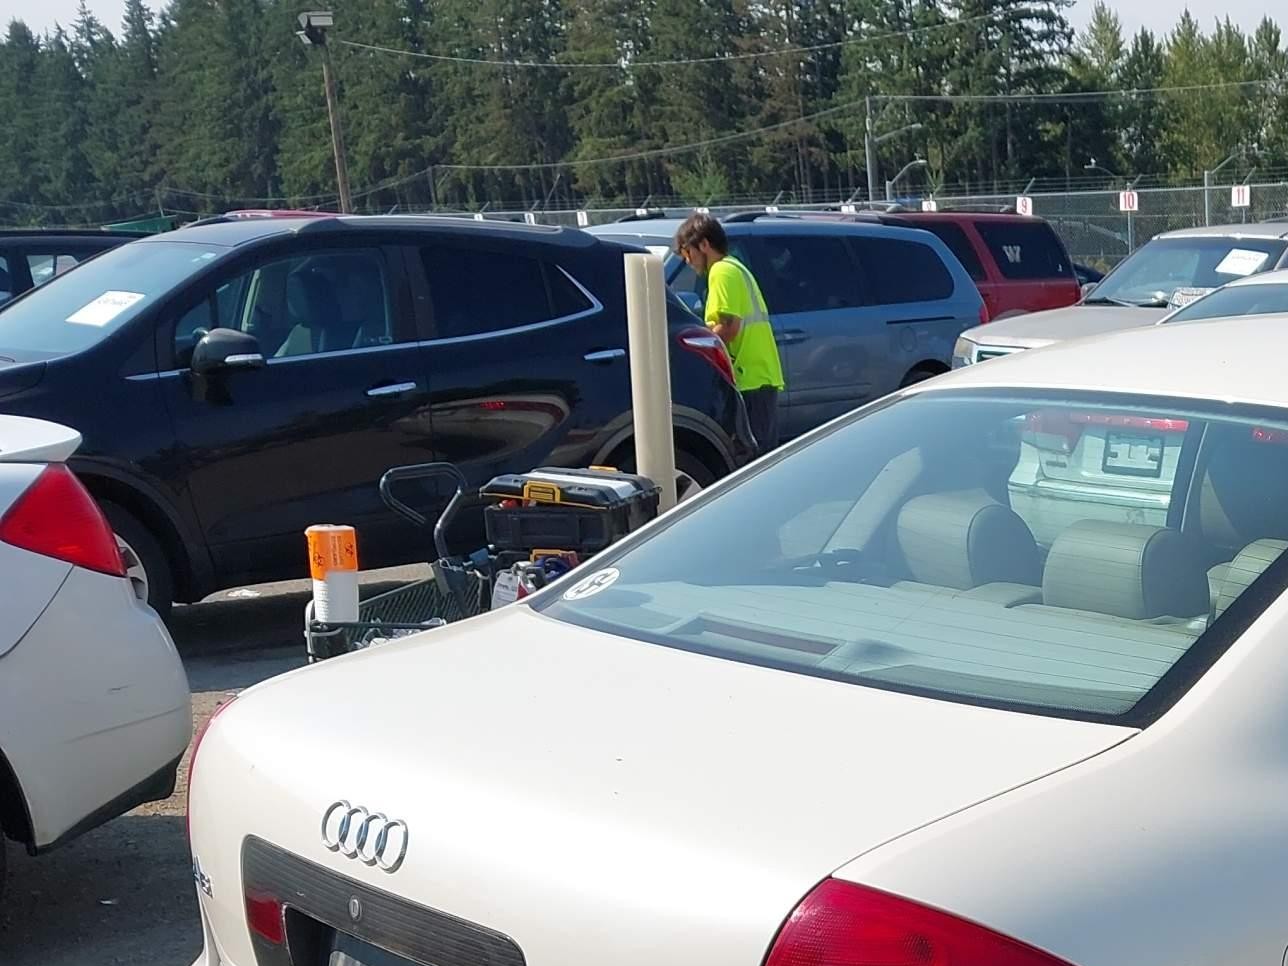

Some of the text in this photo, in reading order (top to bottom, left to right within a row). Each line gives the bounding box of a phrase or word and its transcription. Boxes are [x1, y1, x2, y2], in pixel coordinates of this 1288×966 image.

[1123, 192, 1135, 209] 10
[1236, 187, 1245, 205] 11
[1021, 198, 1028, 214] 9
